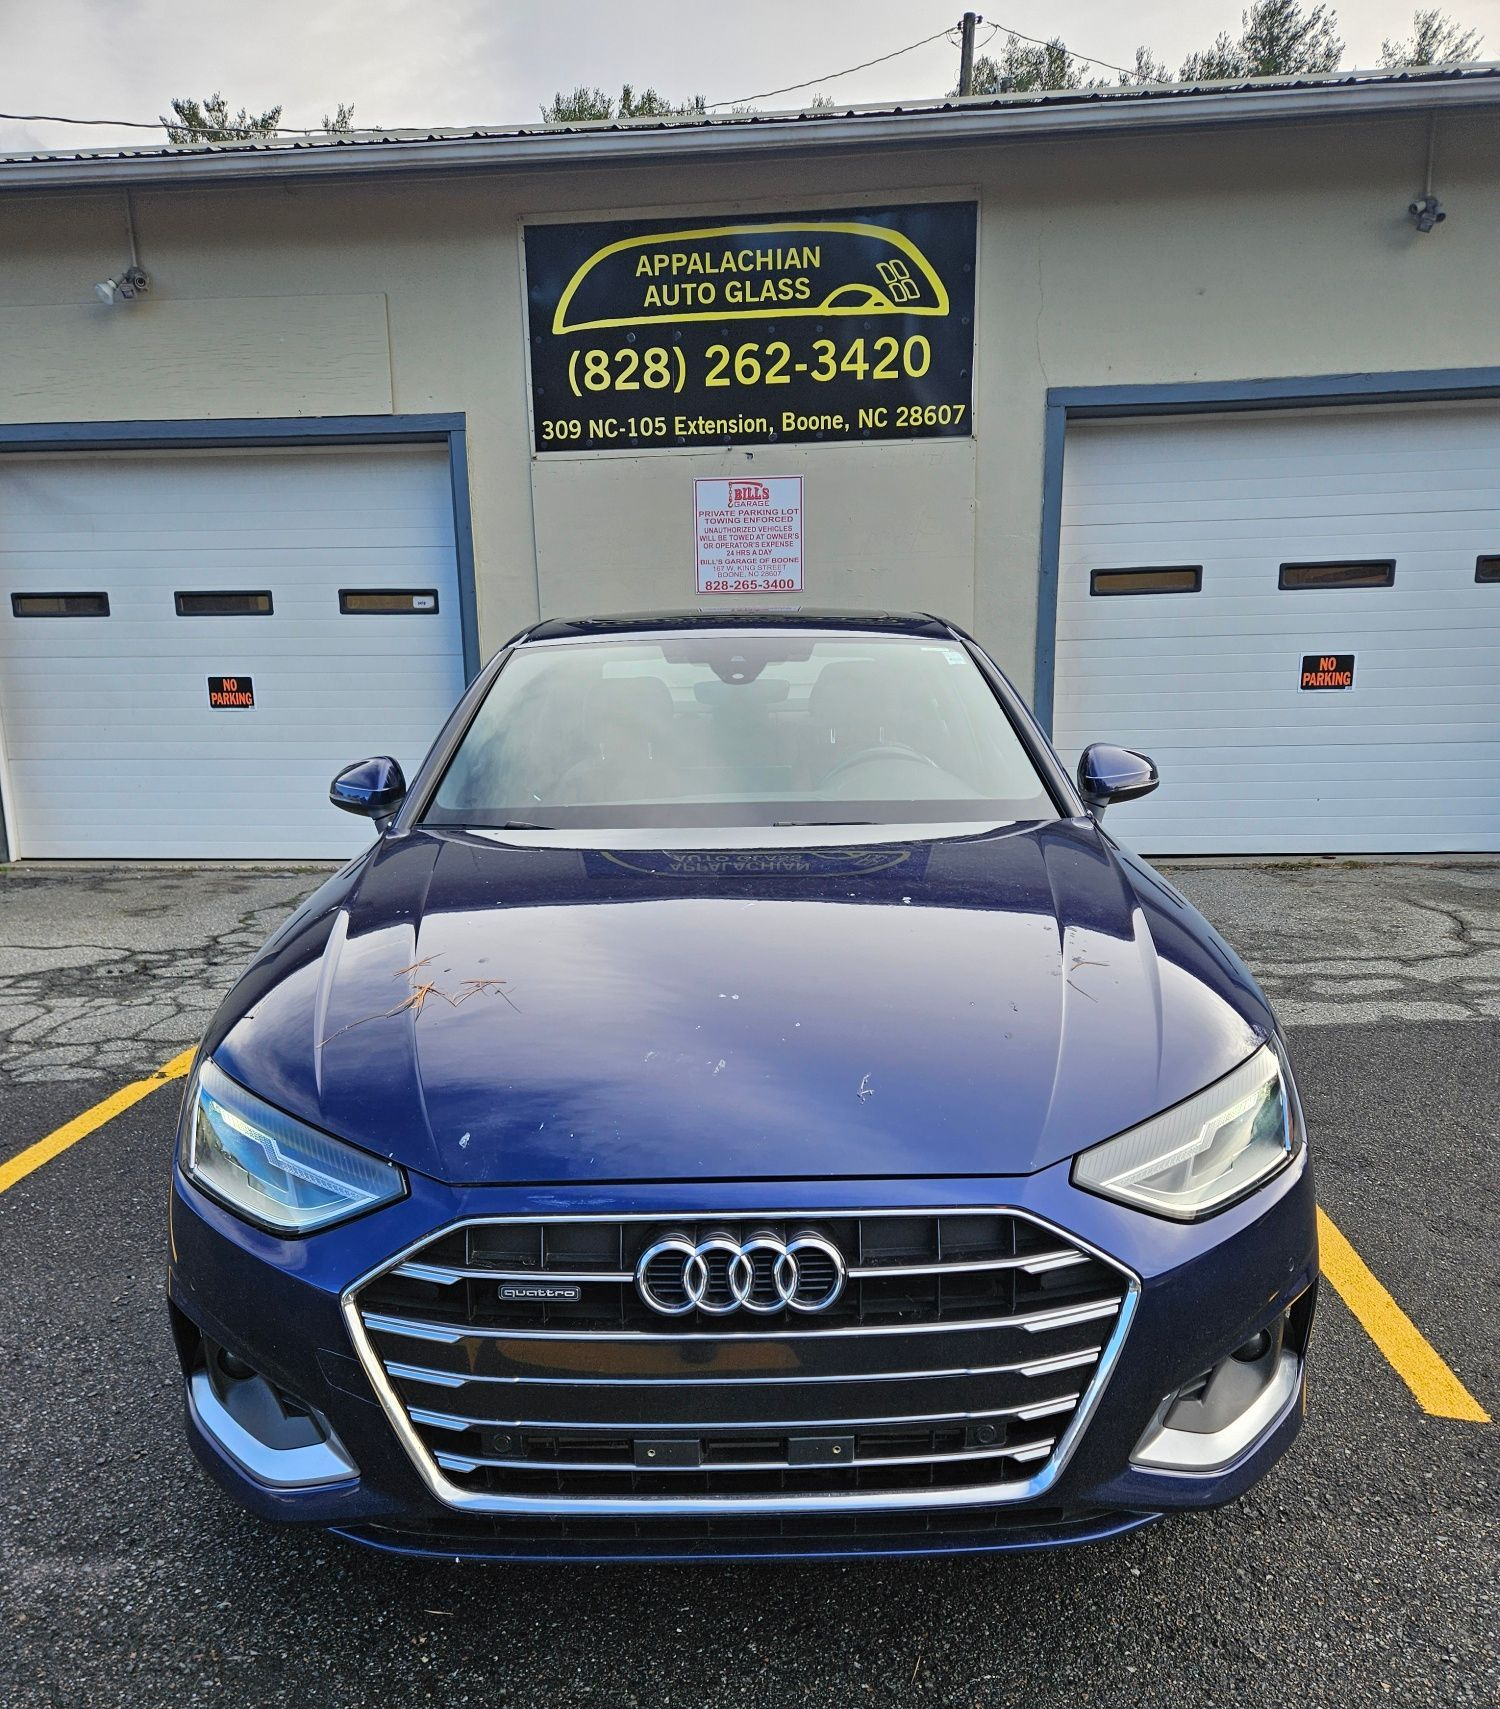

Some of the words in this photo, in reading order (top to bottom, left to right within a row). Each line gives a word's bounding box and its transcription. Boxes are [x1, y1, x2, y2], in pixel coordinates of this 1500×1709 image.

[636, 247, 821, 277] APPALACHIAN
[644, 281, 717, 307] AUTO
[725, 277, 811, 302] GLASS
[568, 347, 686, 397] (828)
[705, 335, 931, 387] 262-3420
[542, 420, 582, 440] 309
[589, 417, 666, 439] NC-105
[675, 414, 775, 436] Extension,
[782, 411, 850, 432] Boone,
[859, 408, 888, 428] NC
[897, 404, 966, 426] 28607
[705, 579, 794, 590] 828-265-3400
[1320, 657, 1336, 671] NO
[223, 679, 237, 691] NO
[1303, 672, 1351, 685] PARKING
[211, 692, 252, 704] PARKING
